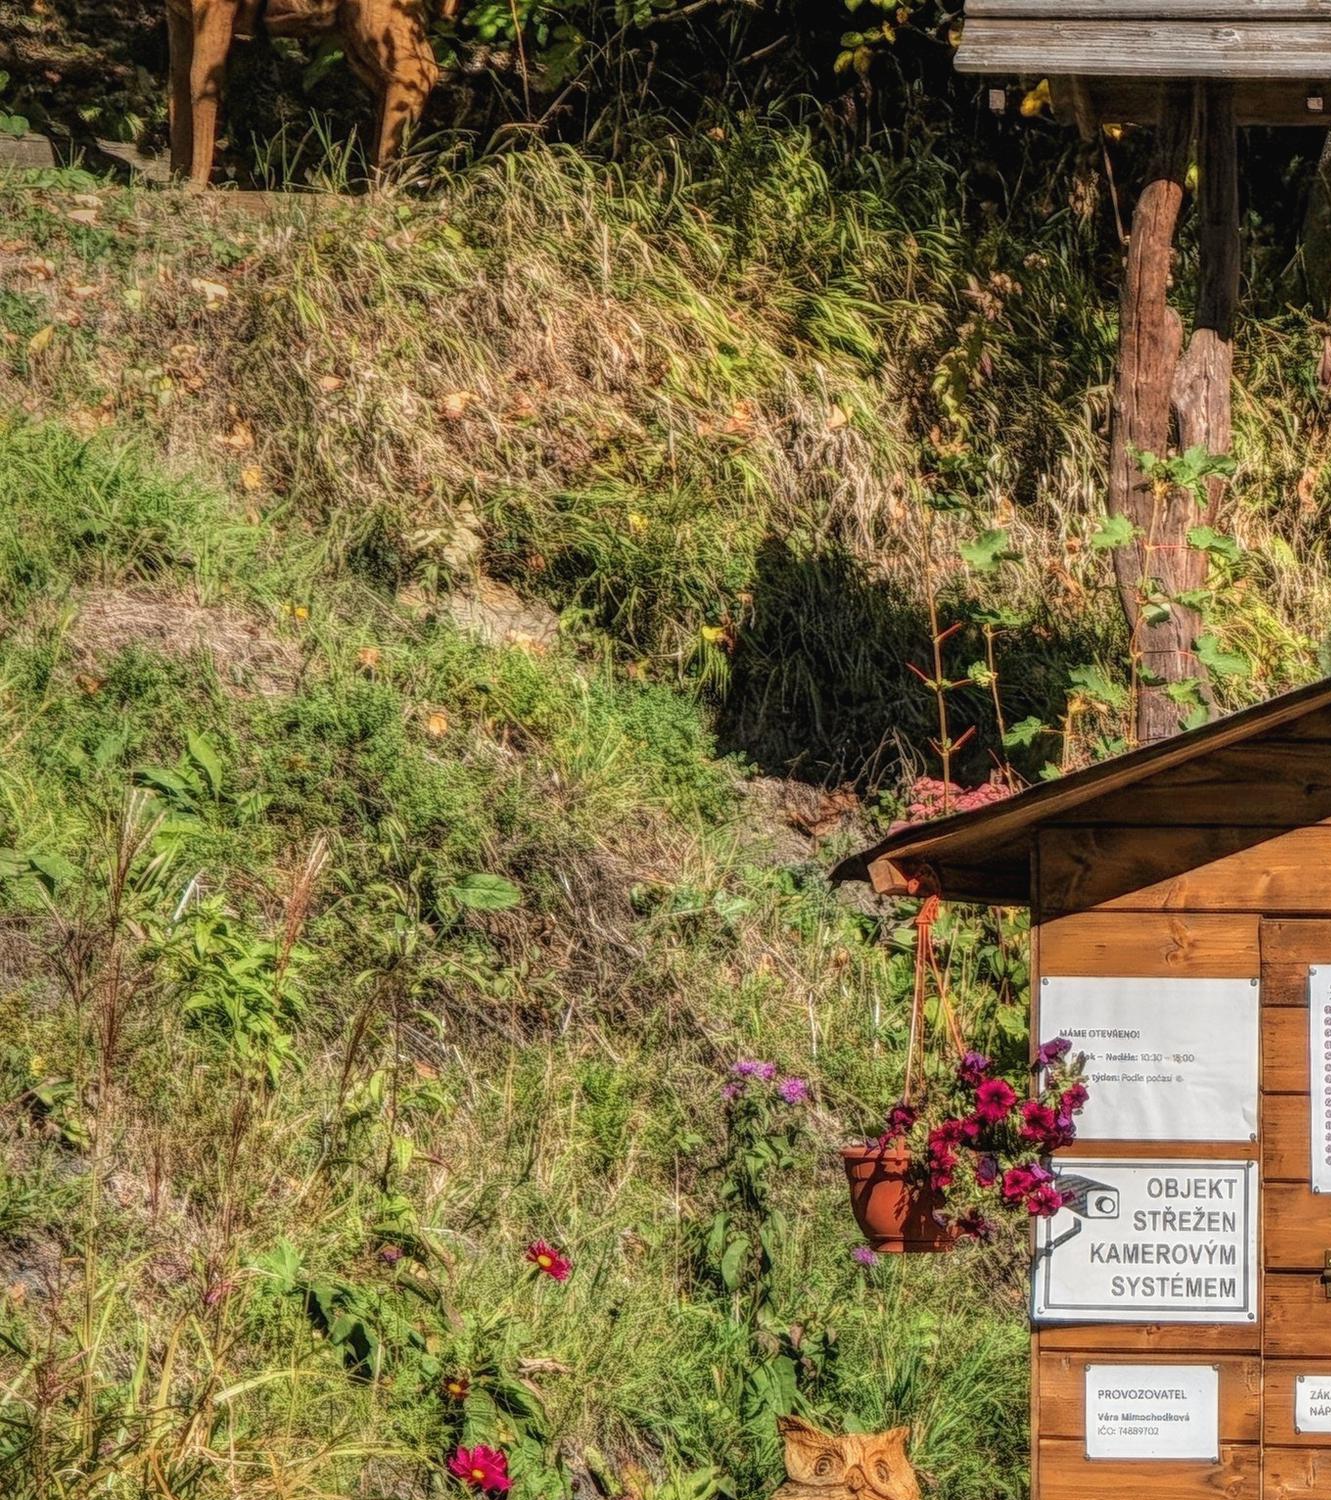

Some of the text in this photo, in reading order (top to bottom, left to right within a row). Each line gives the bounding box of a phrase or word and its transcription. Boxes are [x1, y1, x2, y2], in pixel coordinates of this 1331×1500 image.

[1059, 1028, 1087, 1039] MÁME
[1147, 1178, 1238, 1199] OBJEKT
[1133, 1206, 1236, 1232] STŘEŽEN
[1090, 1240, 1236, 1265] KAMEROVÝM
[1111, 1272, 1236, 1298] SYSTÉMEM
[1097, 1389, 1187, 1400] PROVOZOVATEL
